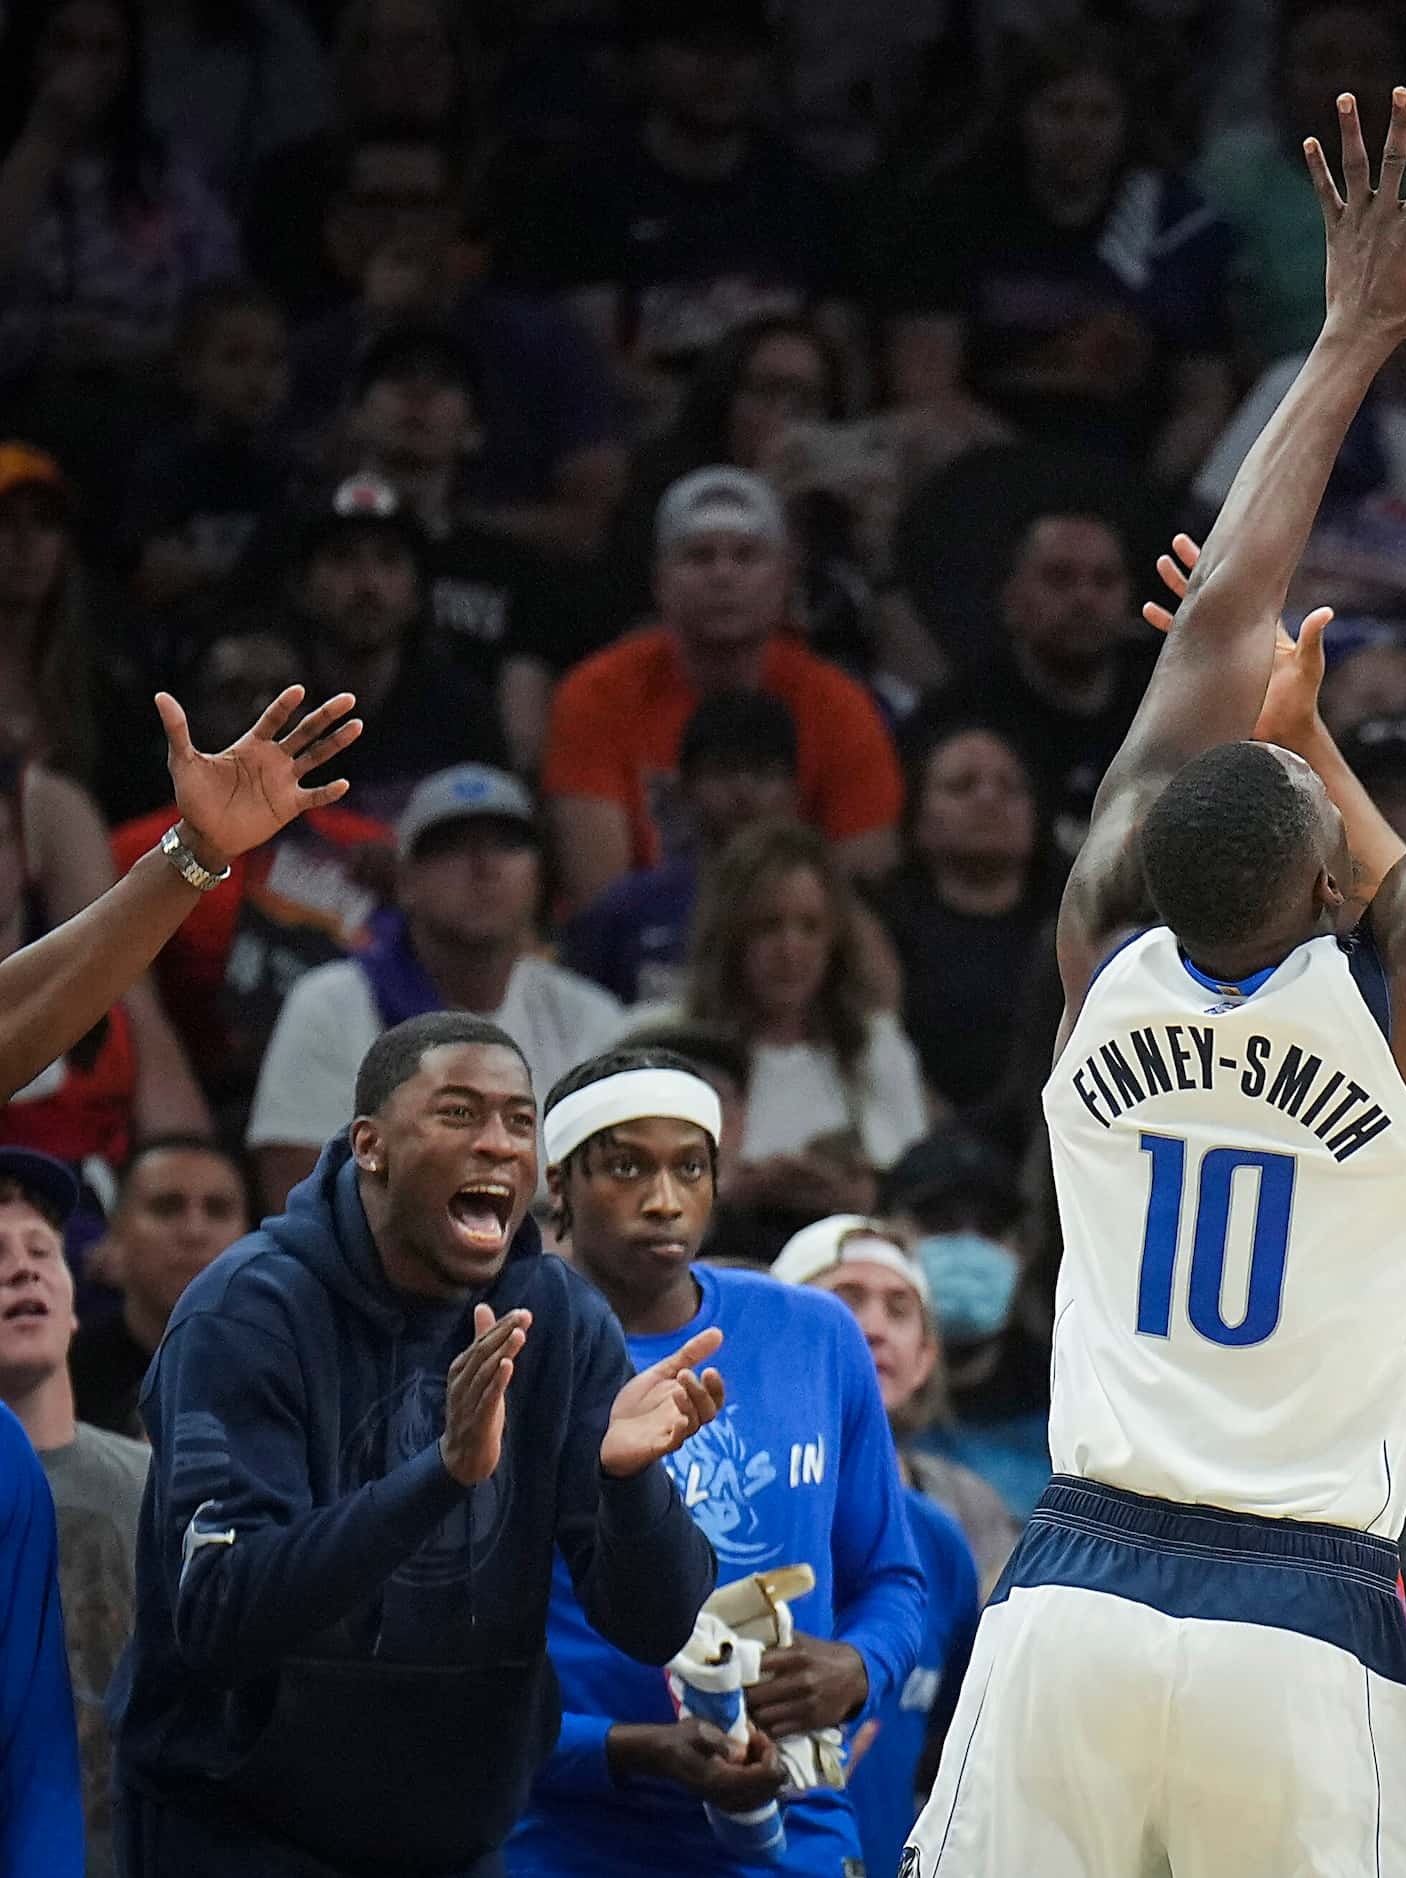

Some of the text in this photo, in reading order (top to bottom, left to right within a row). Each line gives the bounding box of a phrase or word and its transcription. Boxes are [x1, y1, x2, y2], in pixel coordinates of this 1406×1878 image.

[1072, 1025, 1392, 1163] FINNEY-SMITH
[1134, 1129, 1298, 1349] 10
[667, 1432, 826, 1508] LAS IN
